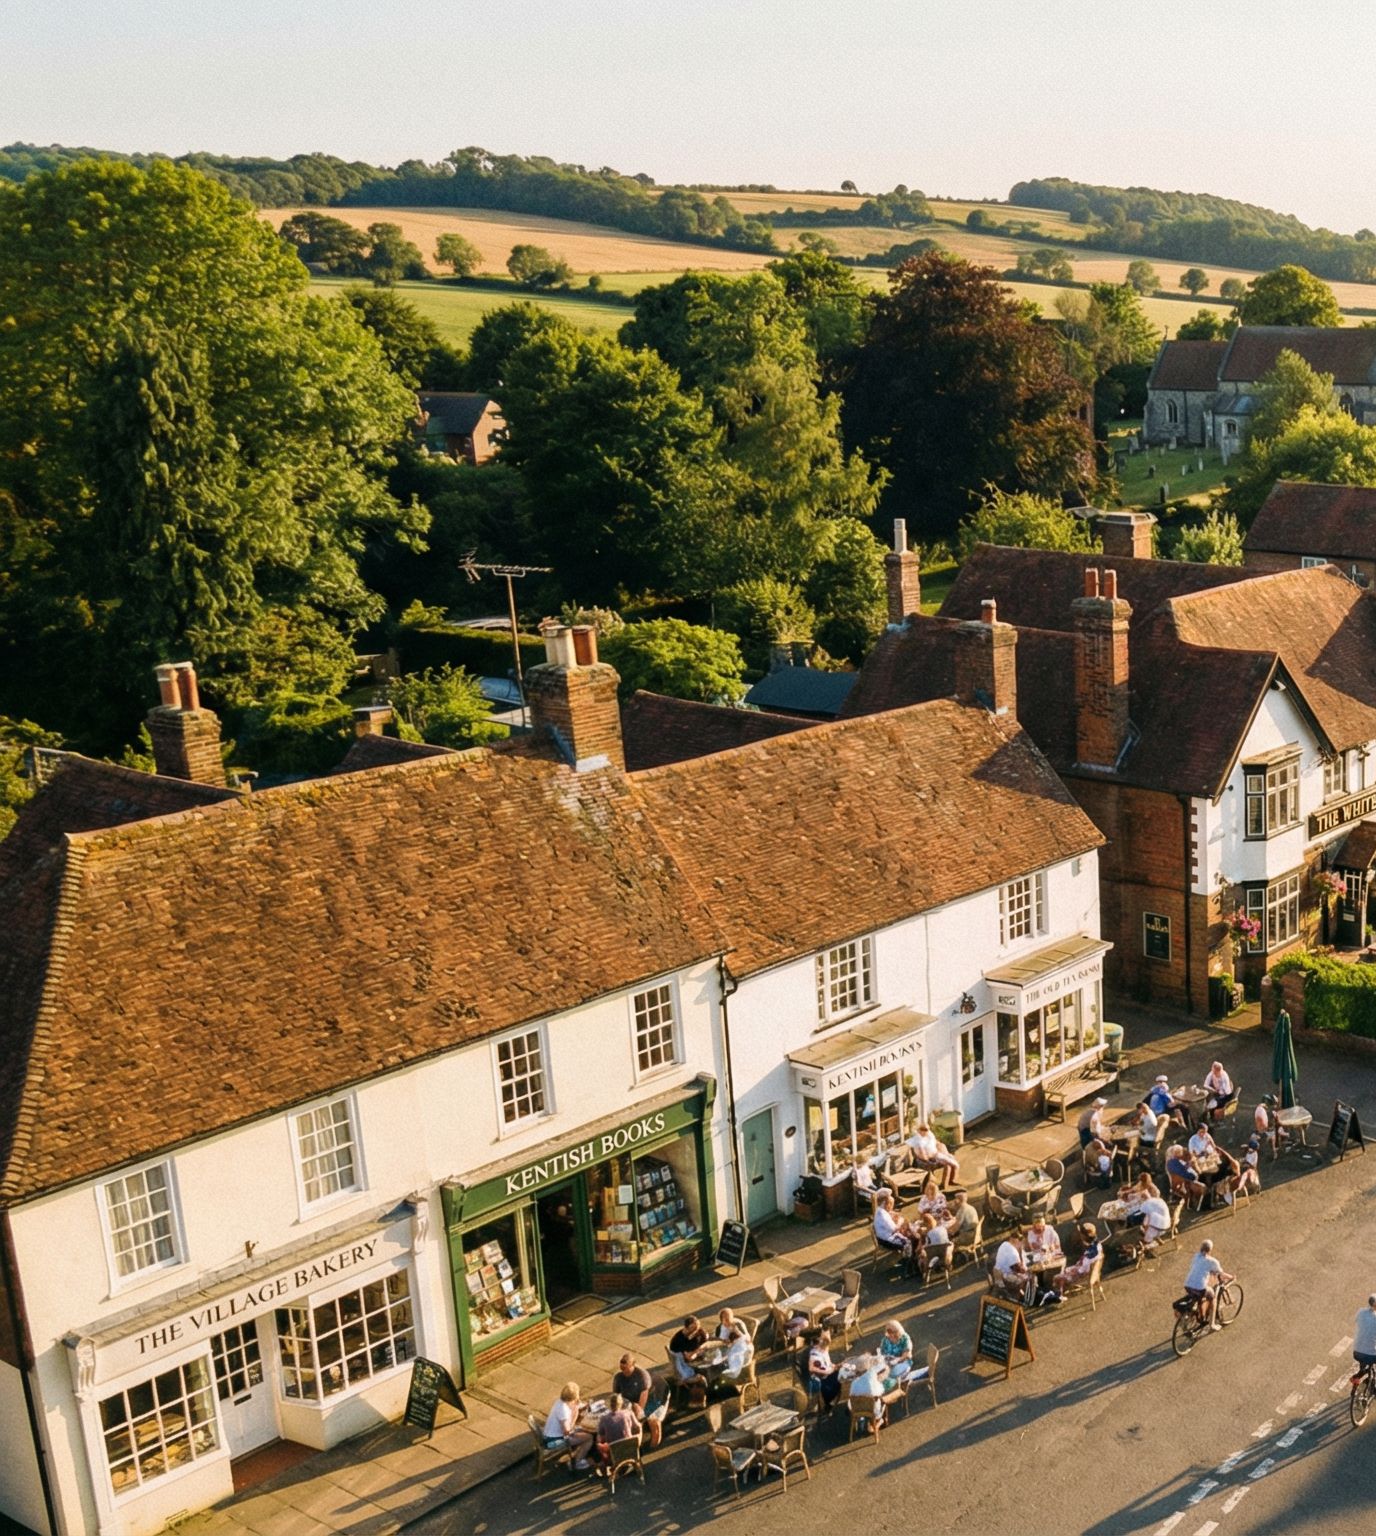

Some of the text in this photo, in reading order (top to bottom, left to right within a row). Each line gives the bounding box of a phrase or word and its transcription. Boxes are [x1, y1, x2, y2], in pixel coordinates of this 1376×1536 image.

[505, 1112, 666, 1196] KENTISH BOOKS
[134, 1239, 377, 1354] THE VILLAGE BAKERY
